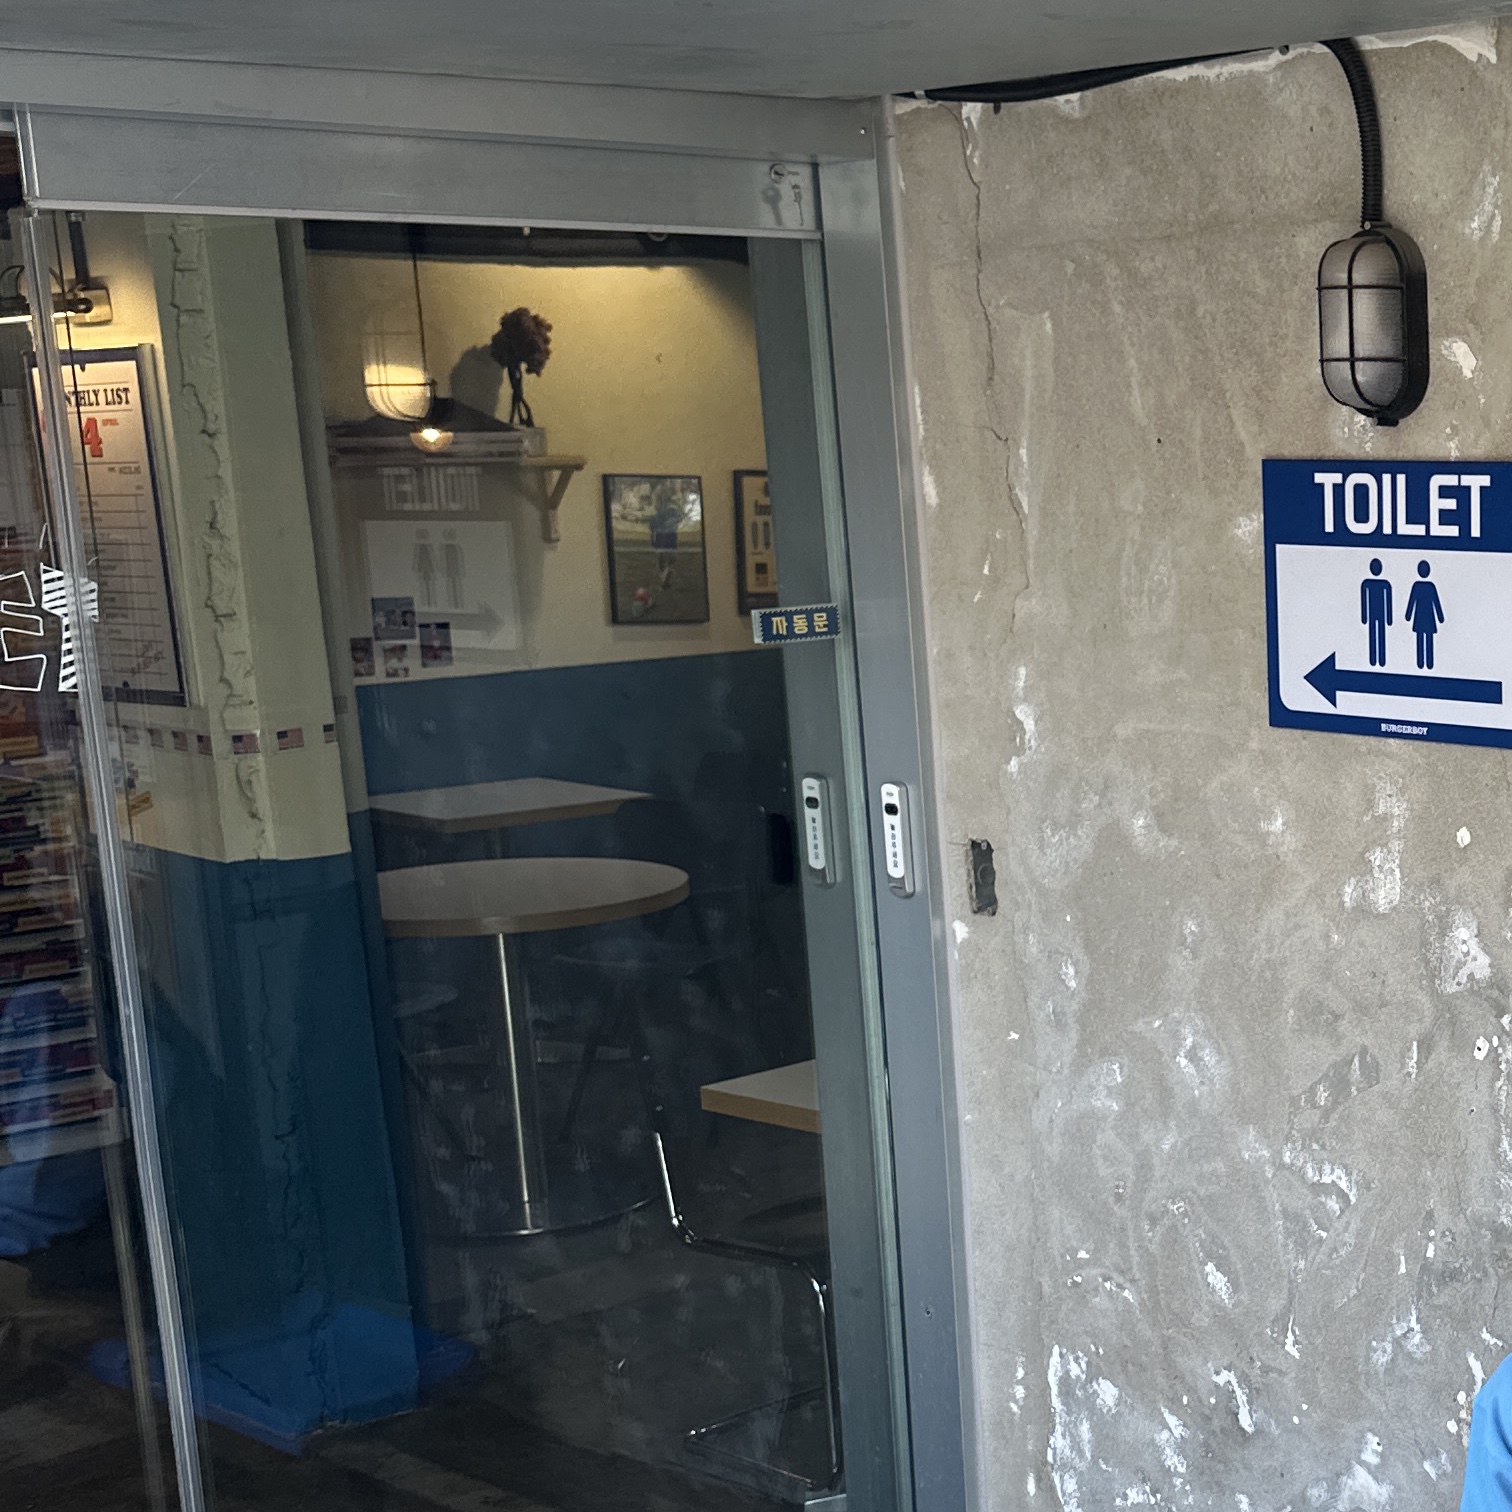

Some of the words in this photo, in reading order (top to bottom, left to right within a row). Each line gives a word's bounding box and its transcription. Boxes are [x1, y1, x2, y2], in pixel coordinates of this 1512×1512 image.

[103, 387, 130, 406] LIST
[1314, 472, 1491, 538] TOILET
[771, 612, 829, 636] 자동문
[1381, 723, 1428, 735] BURGERBOY
